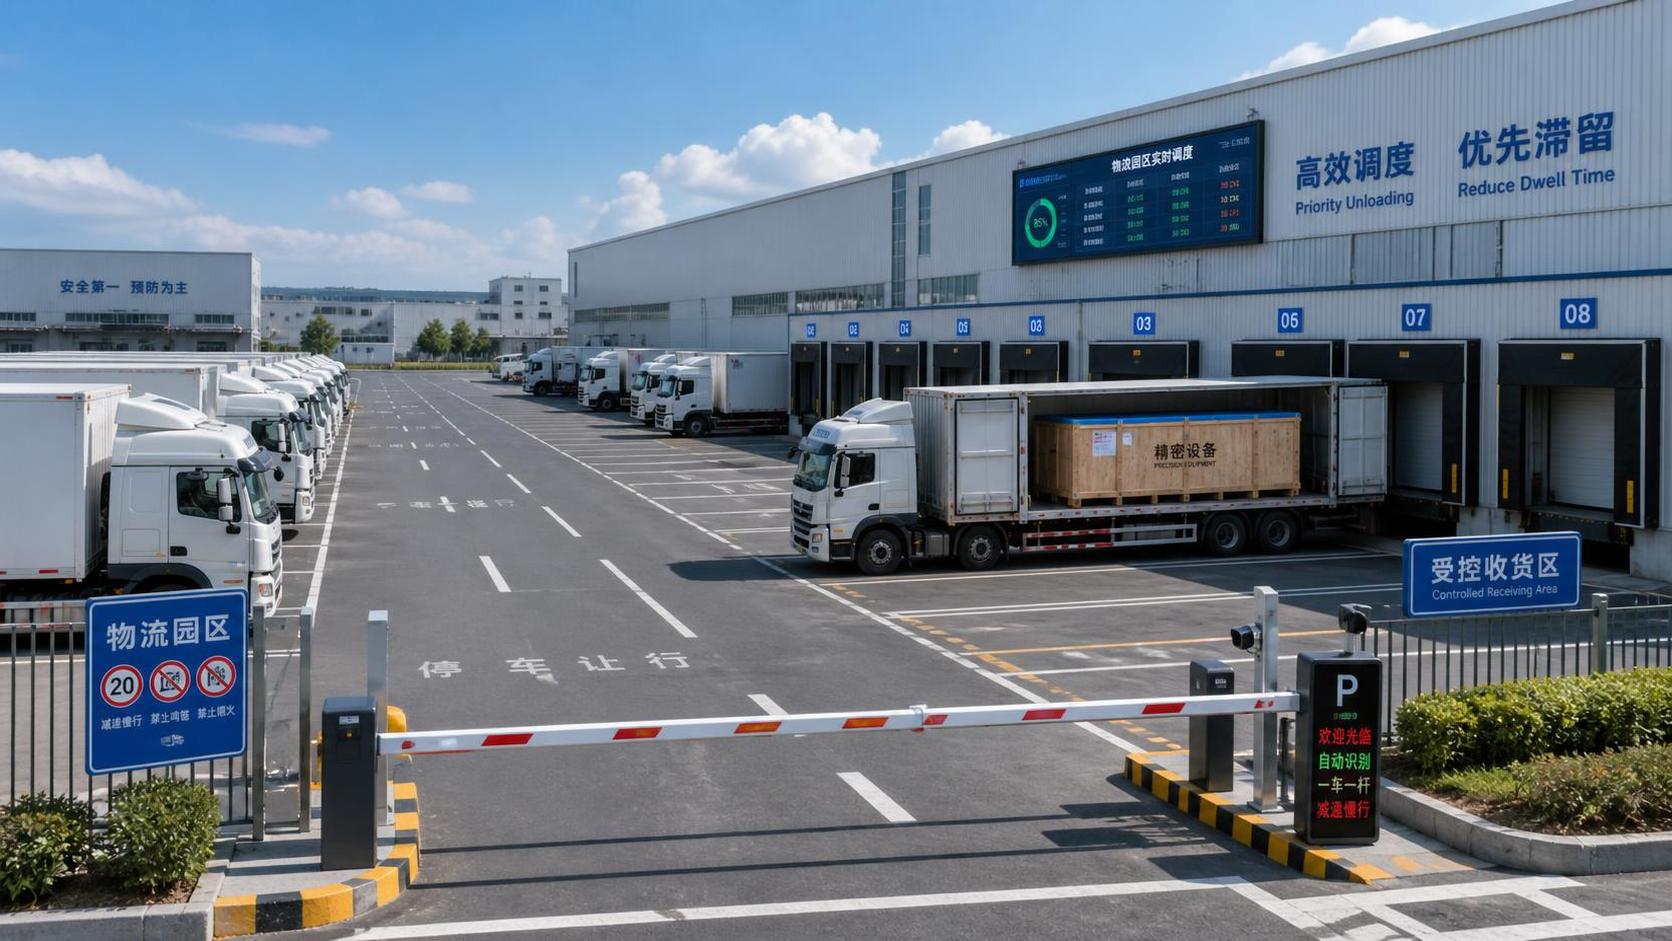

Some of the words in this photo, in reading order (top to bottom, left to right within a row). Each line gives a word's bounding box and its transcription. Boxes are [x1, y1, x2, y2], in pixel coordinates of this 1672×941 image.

[1458, 112, 1613, 169] 优先滞留
[1296, 141, 1415, 190] 高效调度
[1458, 180, 1515, 197] Reduce
[1521, 171, 1565, 191] Dwell
[1571, 169, 1615, 185] Time
[1296, 198, 1342, 215] Priority
[1346, 192, 1414, 210] Unloading
[60, 280, 120, 293] 安全第一
[130, 280, 188, 294] 预防为主
[1136, 316, 1151, 331] 03
[1281, 312, 1299, 329] 06
[1405, 308, 1426, 326] 07
[1565, 303, 1591, 324] 08
[1154, 442, 1216, 460] 精密设备
[1431, 552, 1560, 584] 受控收货区
[1432, 587, 1484, 600] Controlled
[1487, 585, 1533, 598] Receiving
[1535, 584, 1558, 594] Area
[106, 614, 230, 651] 物流园区
[110, 676, 134, 696] 20
[1336, 674, 1359, 707] P
[1318, 728, 1372, 745] 欢迎光临
[1318, 752, 1371, 770] 自动识别
[1317, 775, 1371, 795] 一车一杆
